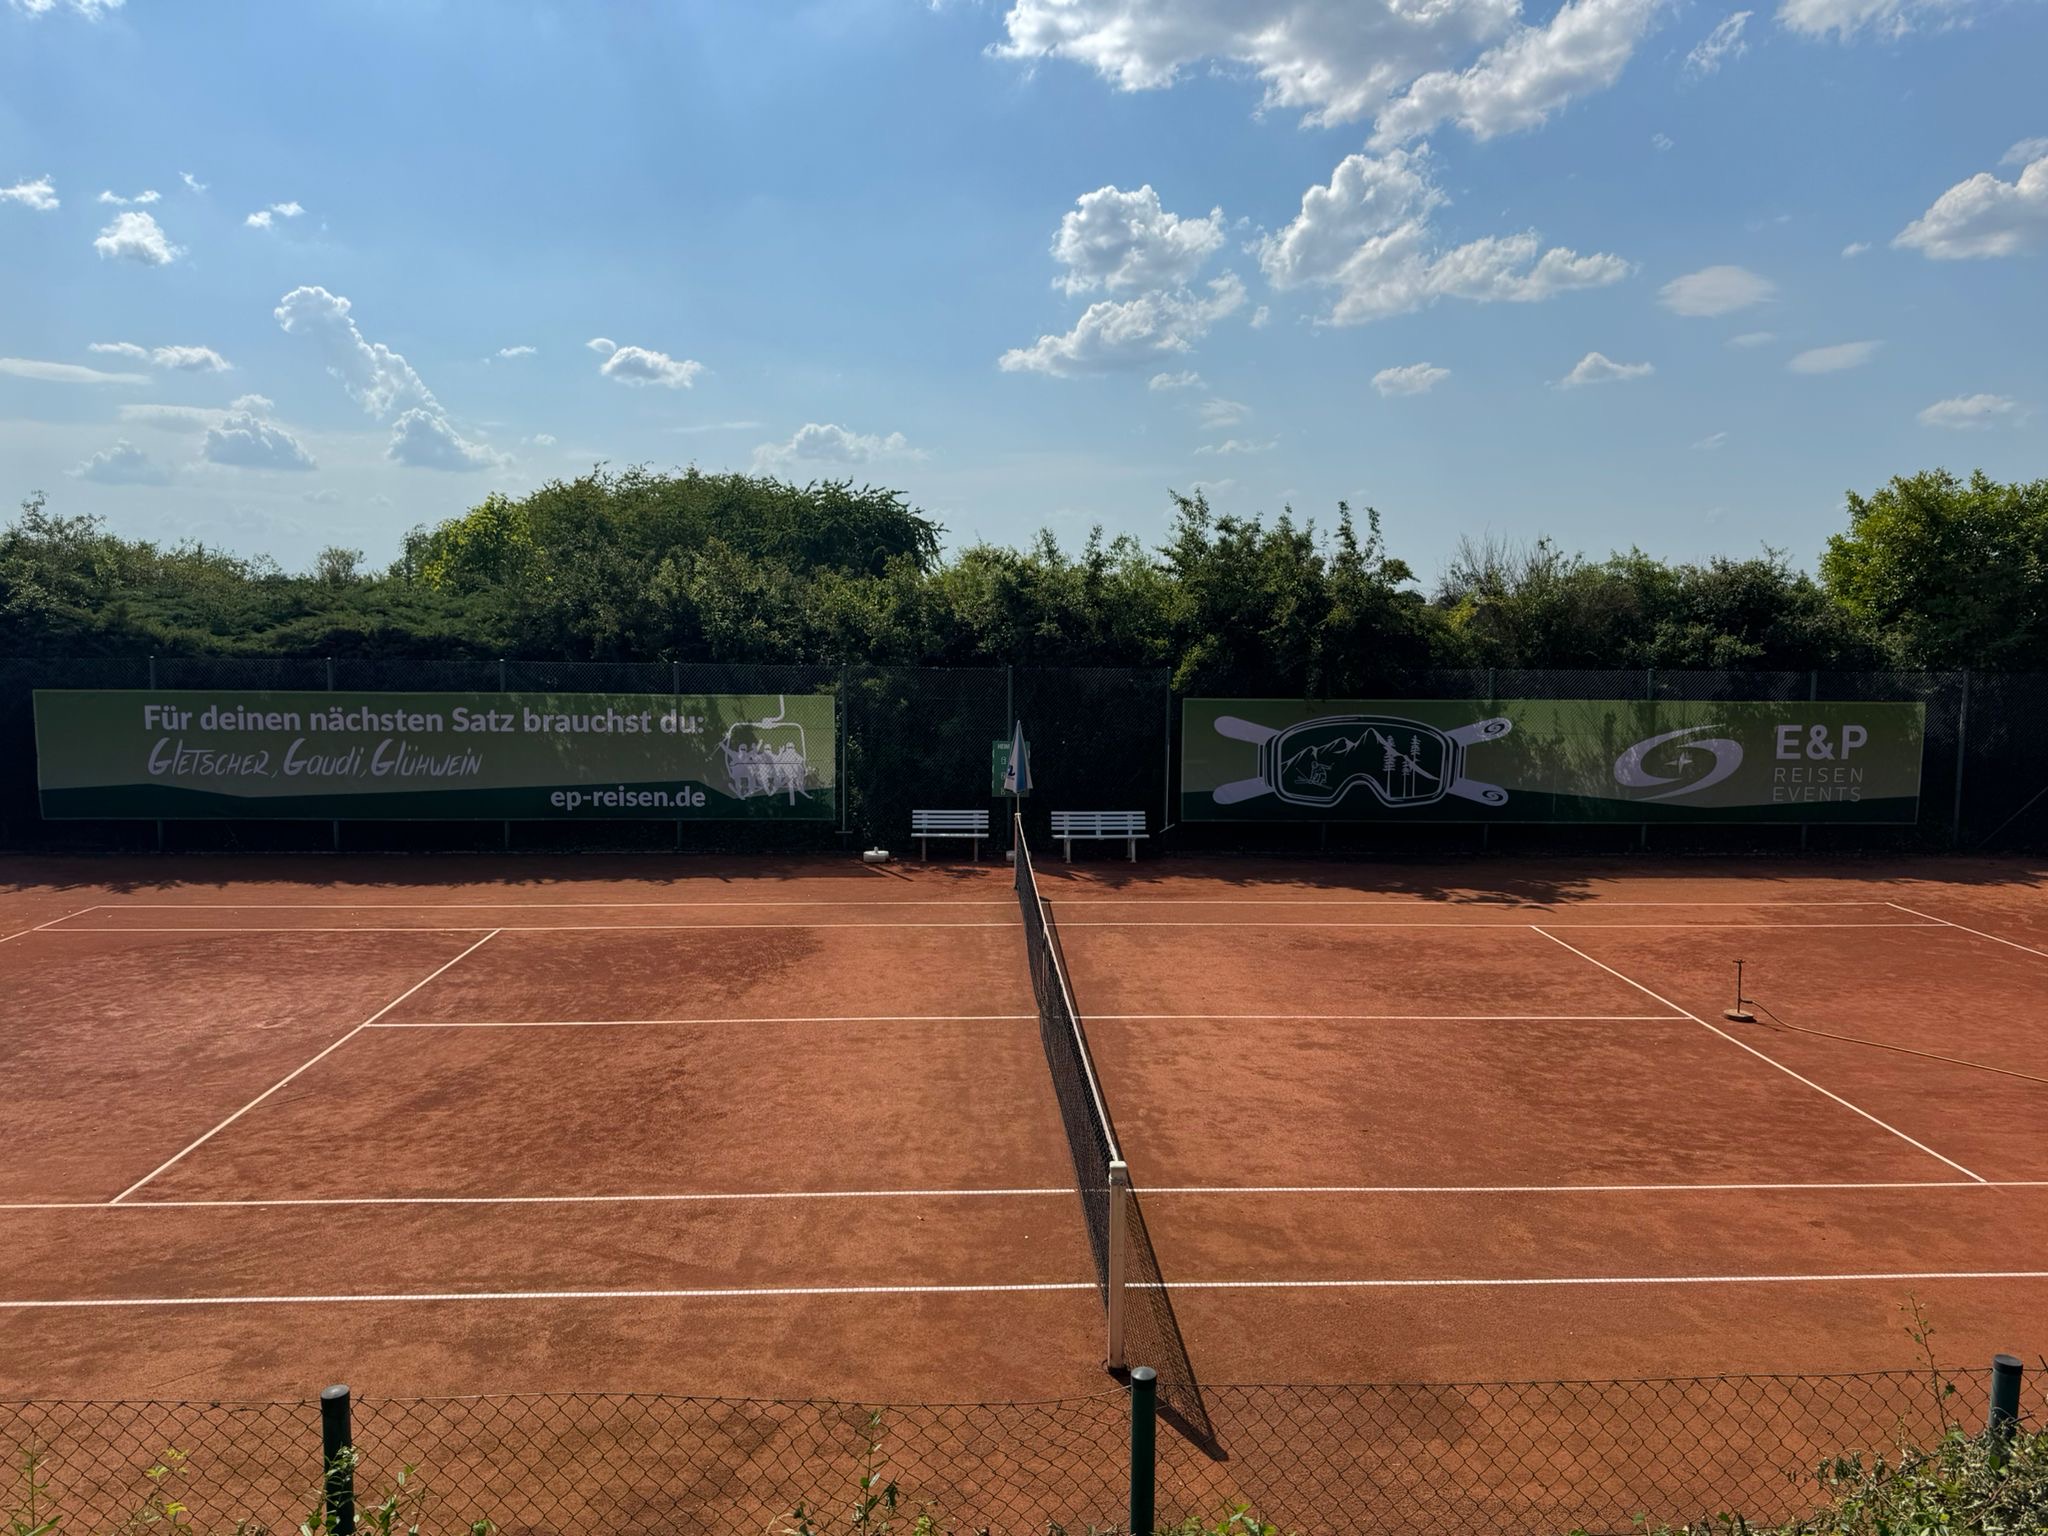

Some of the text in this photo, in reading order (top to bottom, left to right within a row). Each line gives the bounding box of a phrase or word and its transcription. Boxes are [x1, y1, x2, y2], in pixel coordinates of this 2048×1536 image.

[143, 705, 704, 734] Für deinen nächsten Satz brauchst du:
[1775, 724, 1868, 760] E&P
[283, 737, 367, 778] Gaudi,
[1774, 767, 1863, 783] REISEN
[550, 785, 706, 811] ep-reisen.de
[1772, 786, 1861, 802] EVENTS
